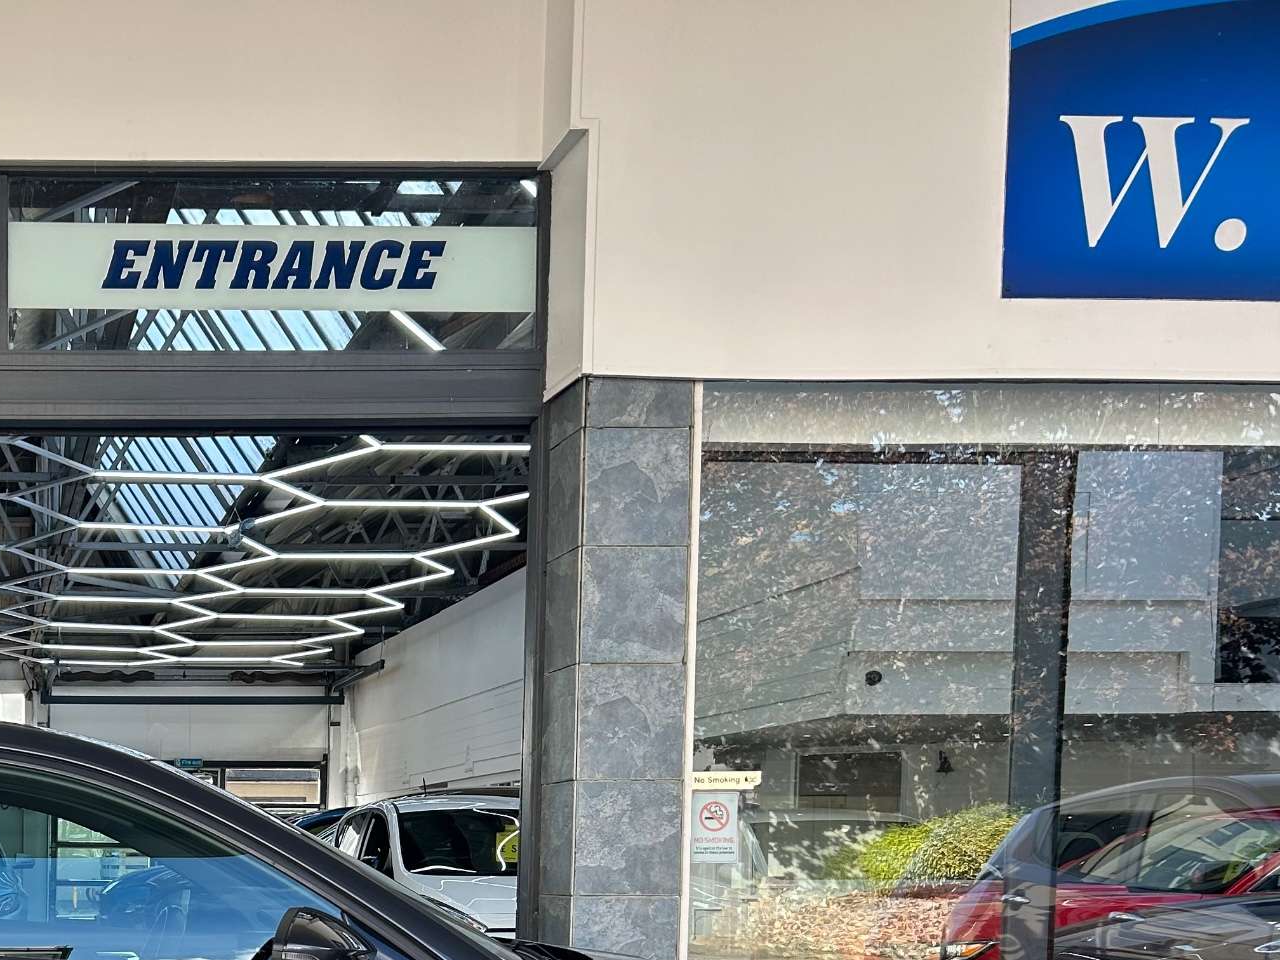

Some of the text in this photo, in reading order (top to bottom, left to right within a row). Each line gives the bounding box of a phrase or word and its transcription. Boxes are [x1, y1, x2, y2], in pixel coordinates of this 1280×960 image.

[1059, 115, 1251, 252] W.
[101, 239, 448, 291] ENTRANCE
[694, 776, 741, 785] No Smoking
